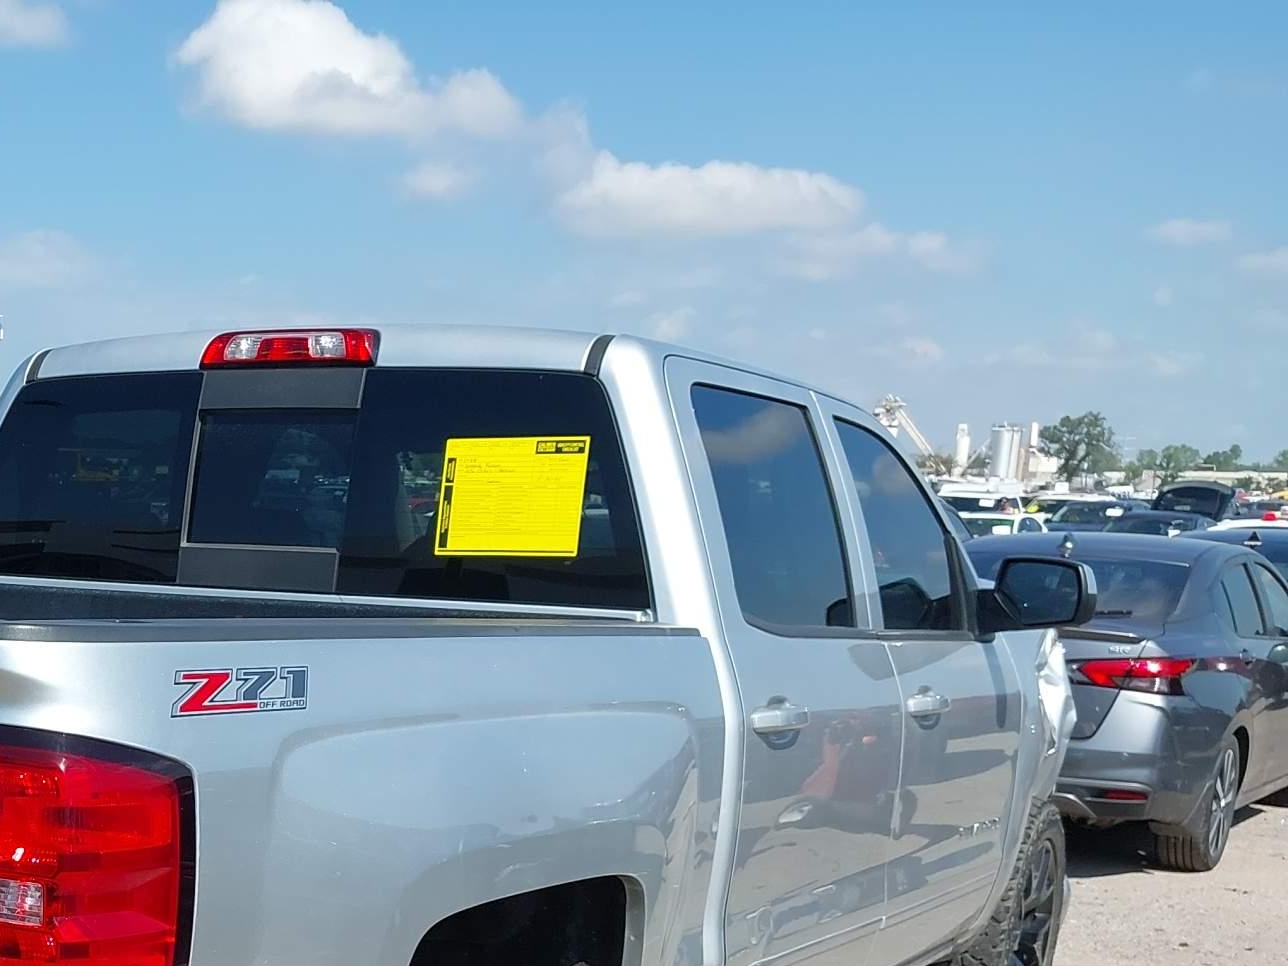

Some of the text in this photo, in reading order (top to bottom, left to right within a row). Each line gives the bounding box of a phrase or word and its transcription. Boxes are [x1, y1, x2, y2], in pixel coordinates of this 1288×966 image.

[170, 665, 309, 718] Z71
[259, 699, 306, 709] OFF ROAD
